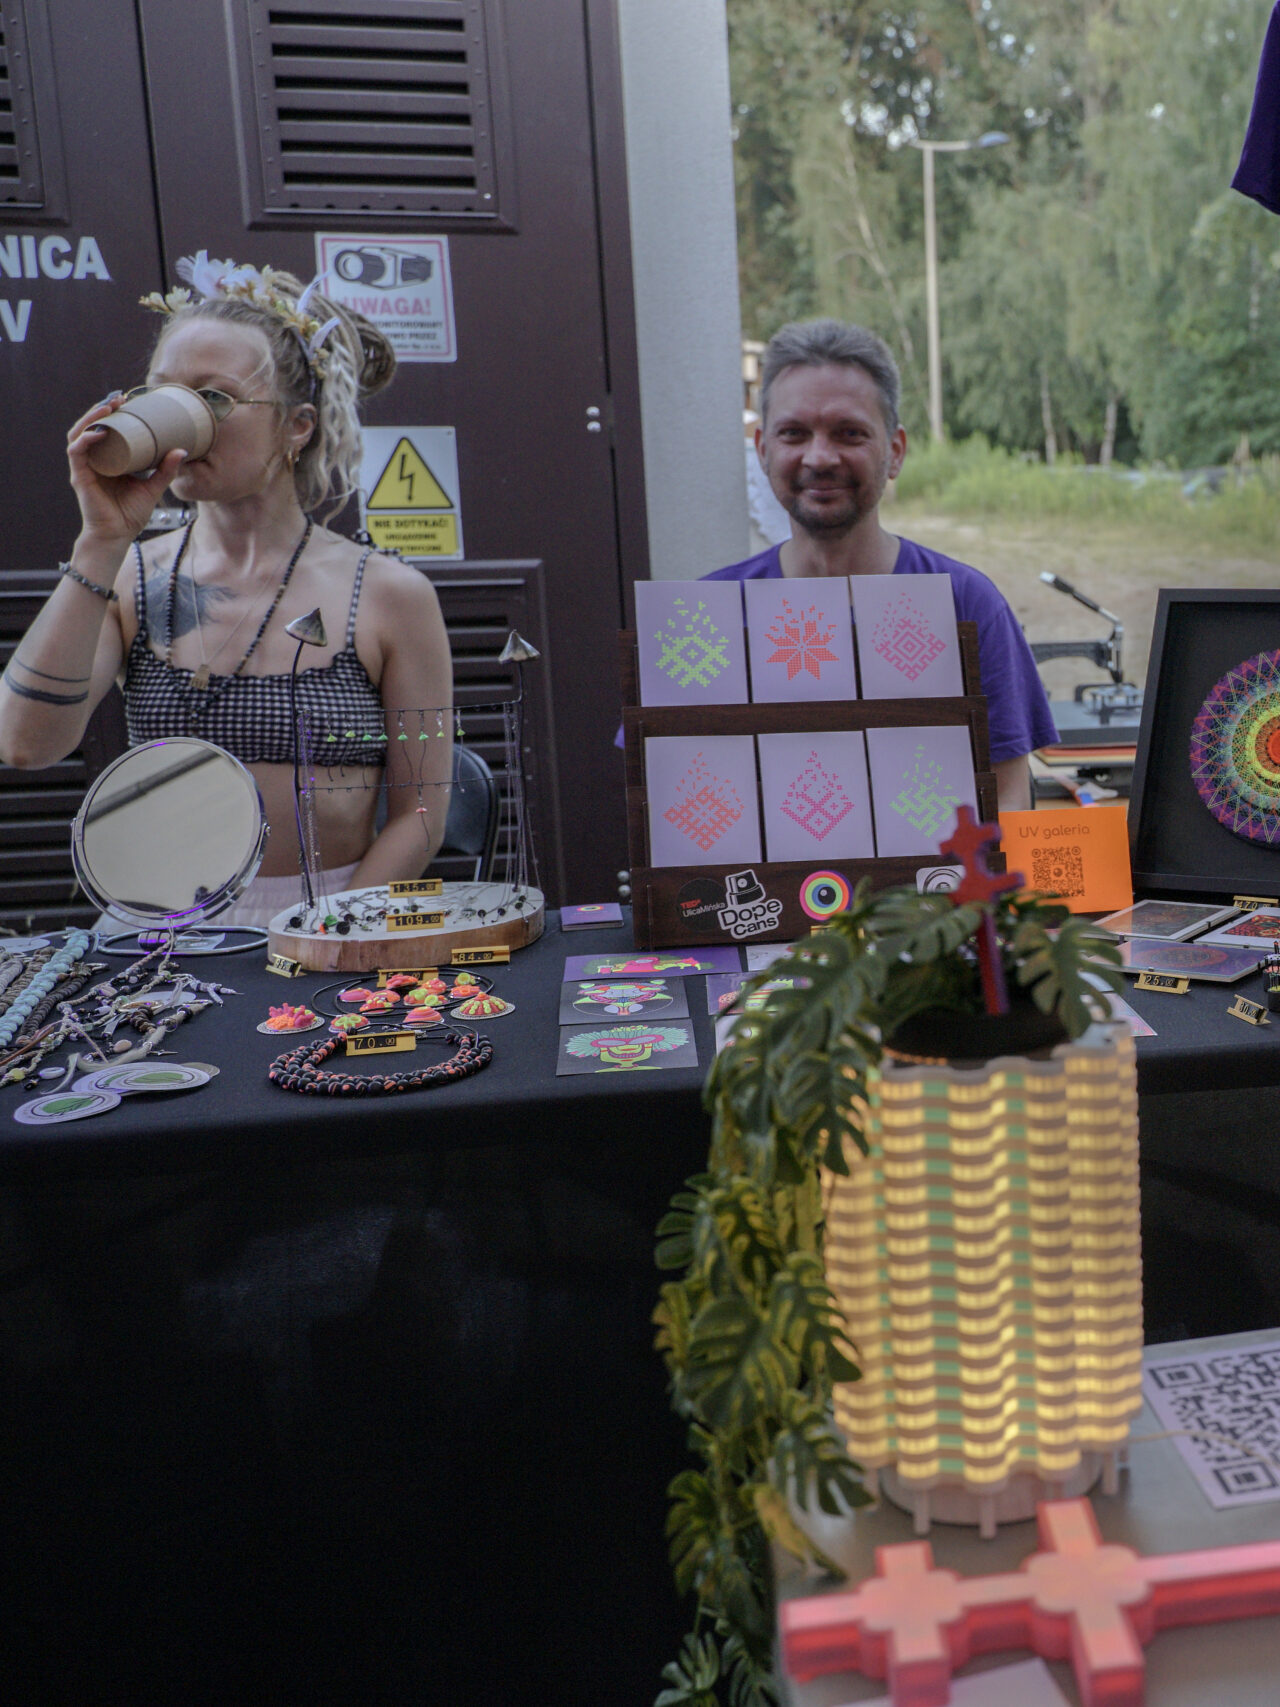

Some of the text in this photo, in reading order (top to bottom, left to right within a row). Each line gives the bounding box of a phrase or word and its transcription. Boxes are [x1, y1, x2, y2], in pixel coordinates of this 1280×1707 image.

[0, 235, 112, 280] NICA
[343, 296, 432, 316] UWAGA!
[0, 298, 33, 342] V
[1019, 824, 1090, 839] UV galeria
[682, 901, 726, 917] UlicaMińska
[721, 900, 781, 926] Dope
